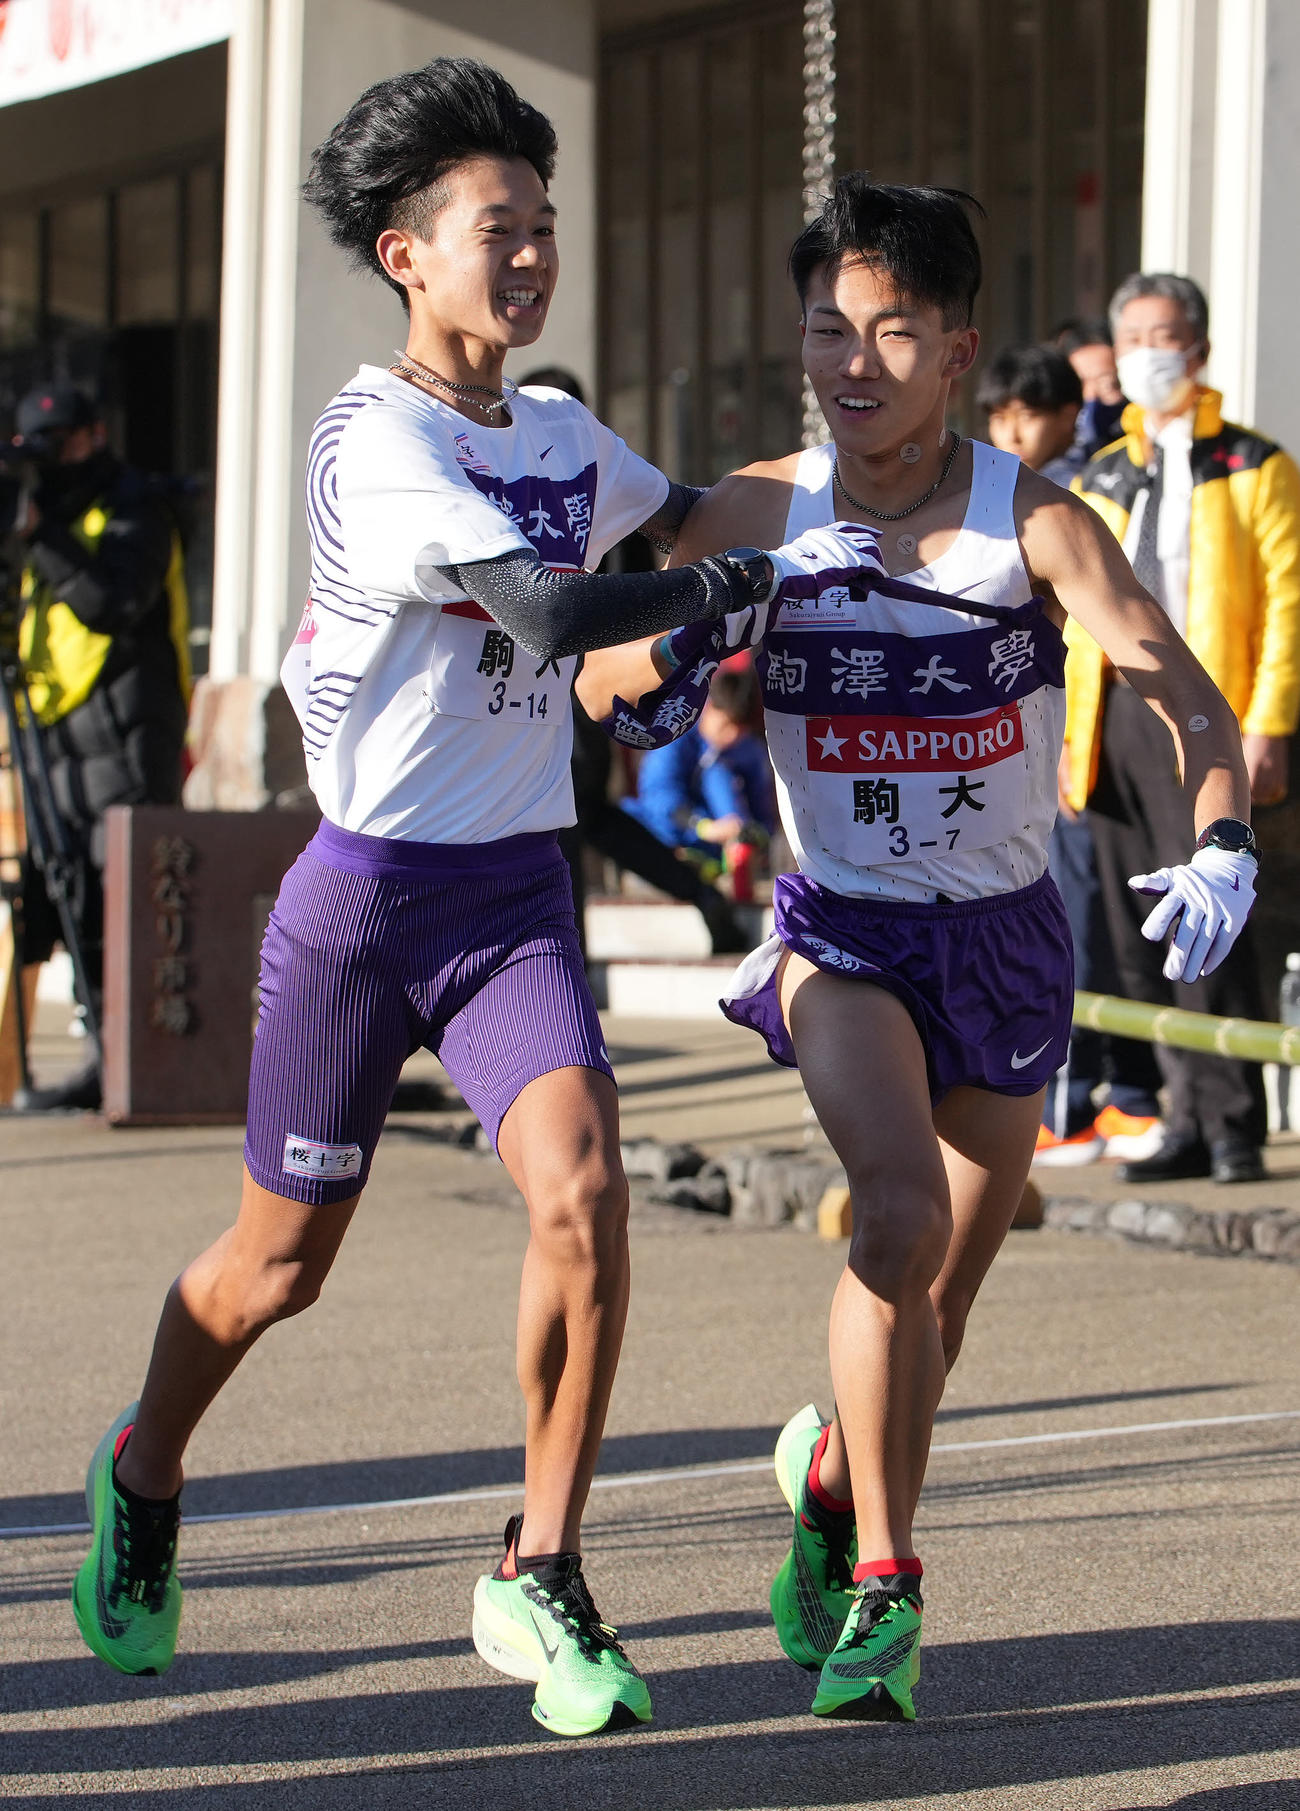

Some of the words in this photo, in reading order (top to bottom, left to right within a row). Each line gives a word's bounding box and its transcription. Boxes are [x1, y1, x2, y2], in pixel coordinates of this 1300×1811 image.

[488, 681, 548, 719] 3-14
[857, 718, 1015, 761] SAPPORO
[888, 825, 961, 858] 3-7
[291, 1146, 356, 1168] 桜十字
